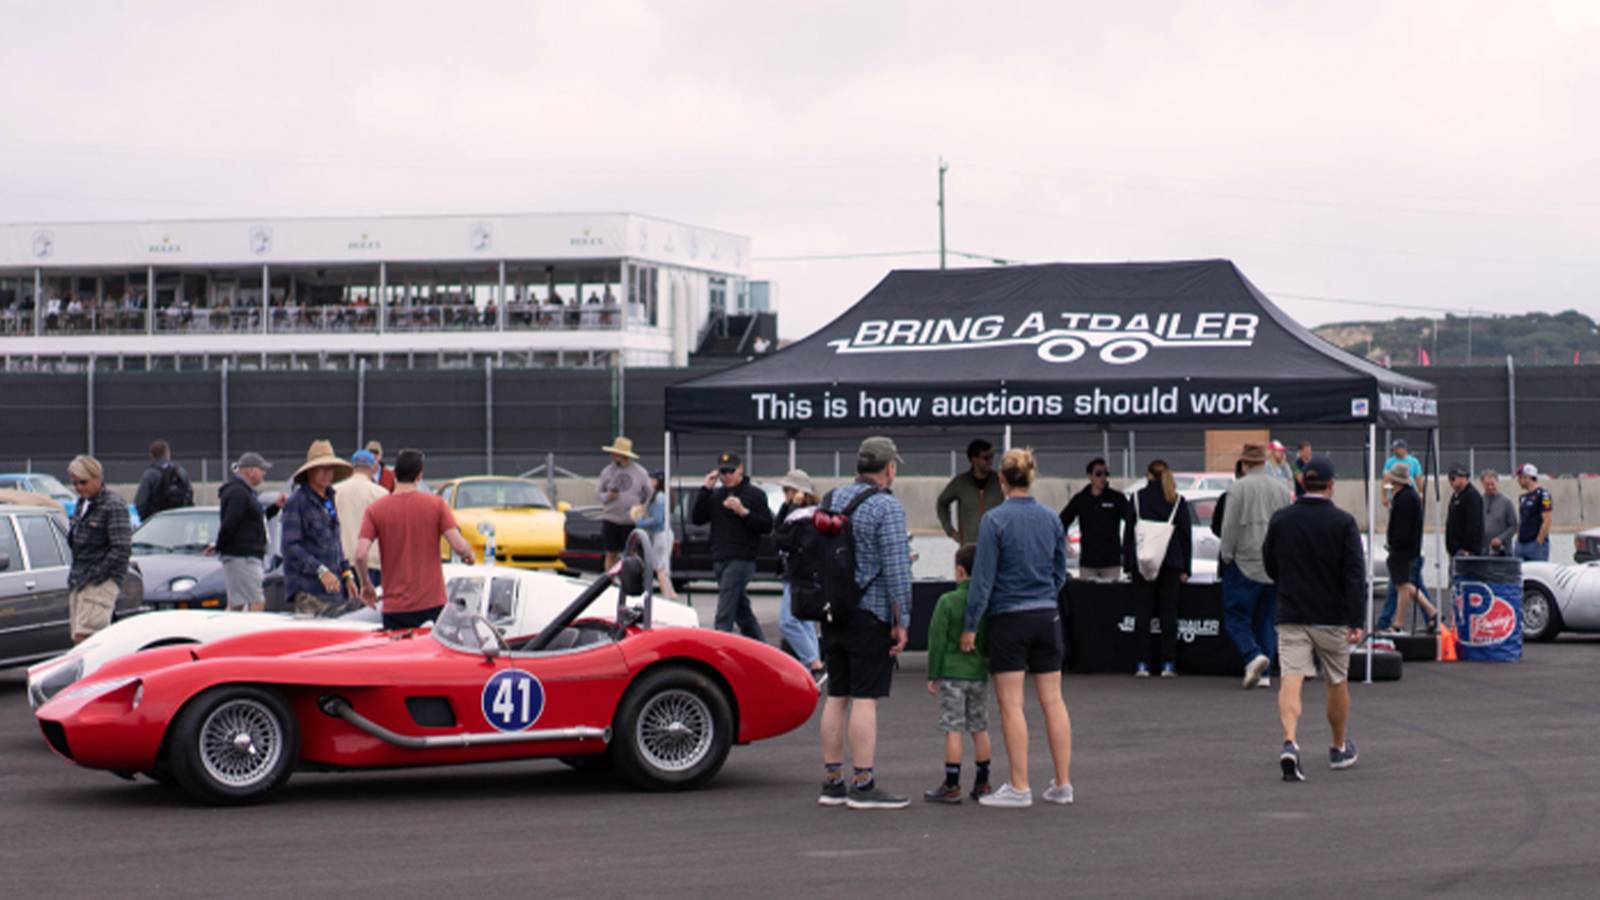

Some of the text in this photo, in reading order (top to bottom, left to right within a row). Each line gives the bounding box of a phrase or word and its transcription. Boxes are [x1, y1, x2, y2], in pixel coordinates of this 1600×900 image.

[852, 311, 1259, 345] BRING A TRAILER
[751, 386, 1279, 420] This is how auctions should work.
[493, 678, 531, 723] 41
